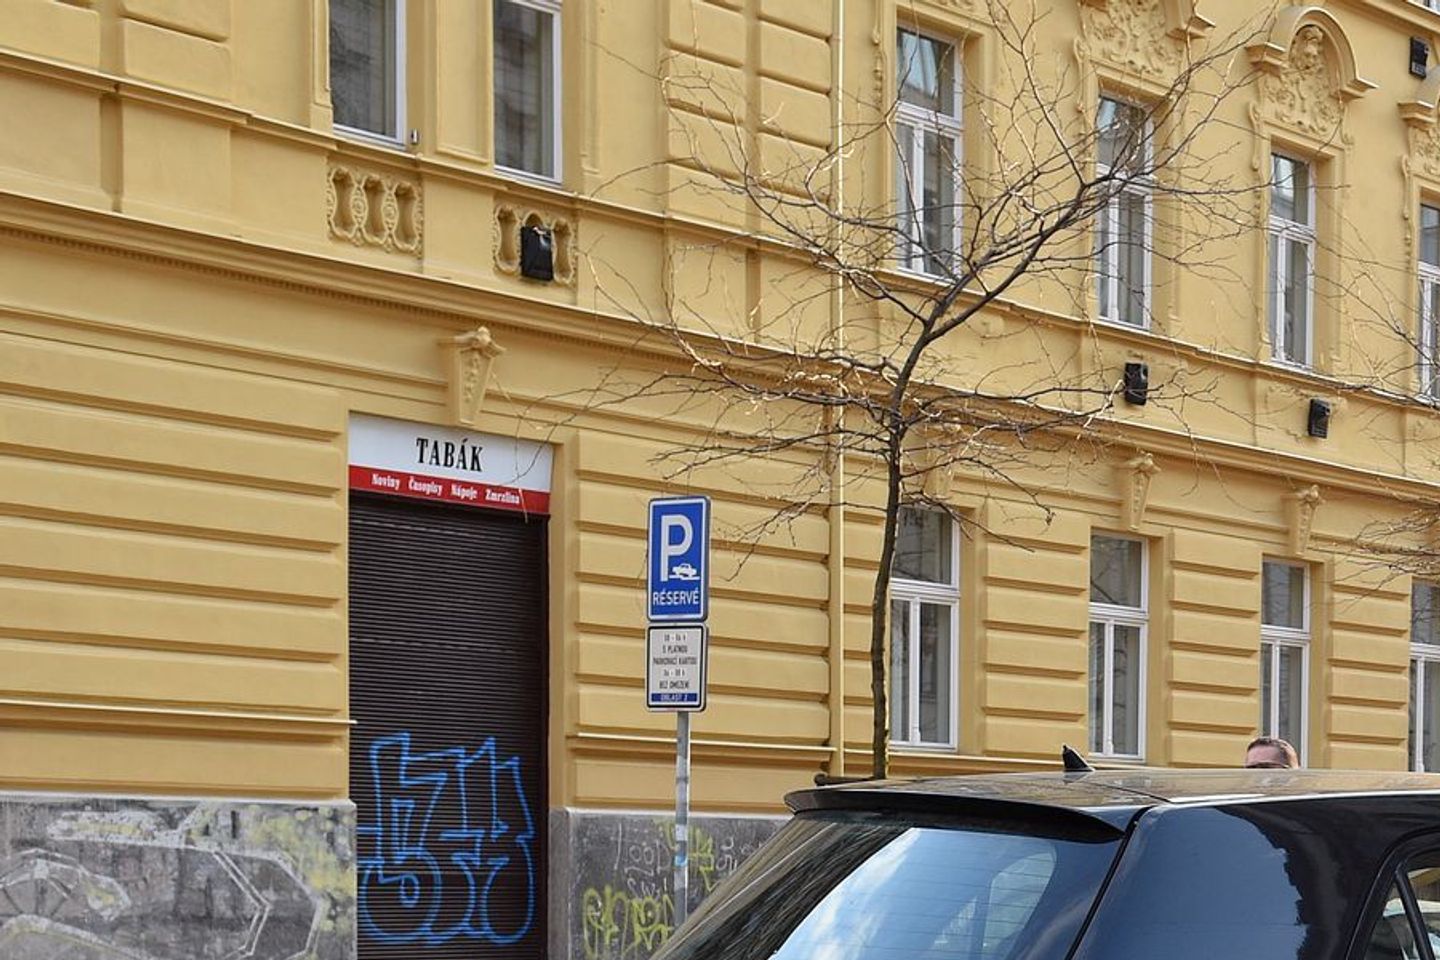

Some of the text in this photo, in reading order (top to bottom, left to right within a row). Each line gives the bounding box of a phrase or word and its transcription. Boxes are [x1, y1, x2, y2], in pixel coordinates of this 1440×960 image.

[416, 437, 483, 472] TABÁK
[372, 473, 520, 504] Noviny Časopisy Nápoje Zmrzlina
[660, 514, 693, 582] P
[653, 588, 699, 606] RÉSERVÉ
